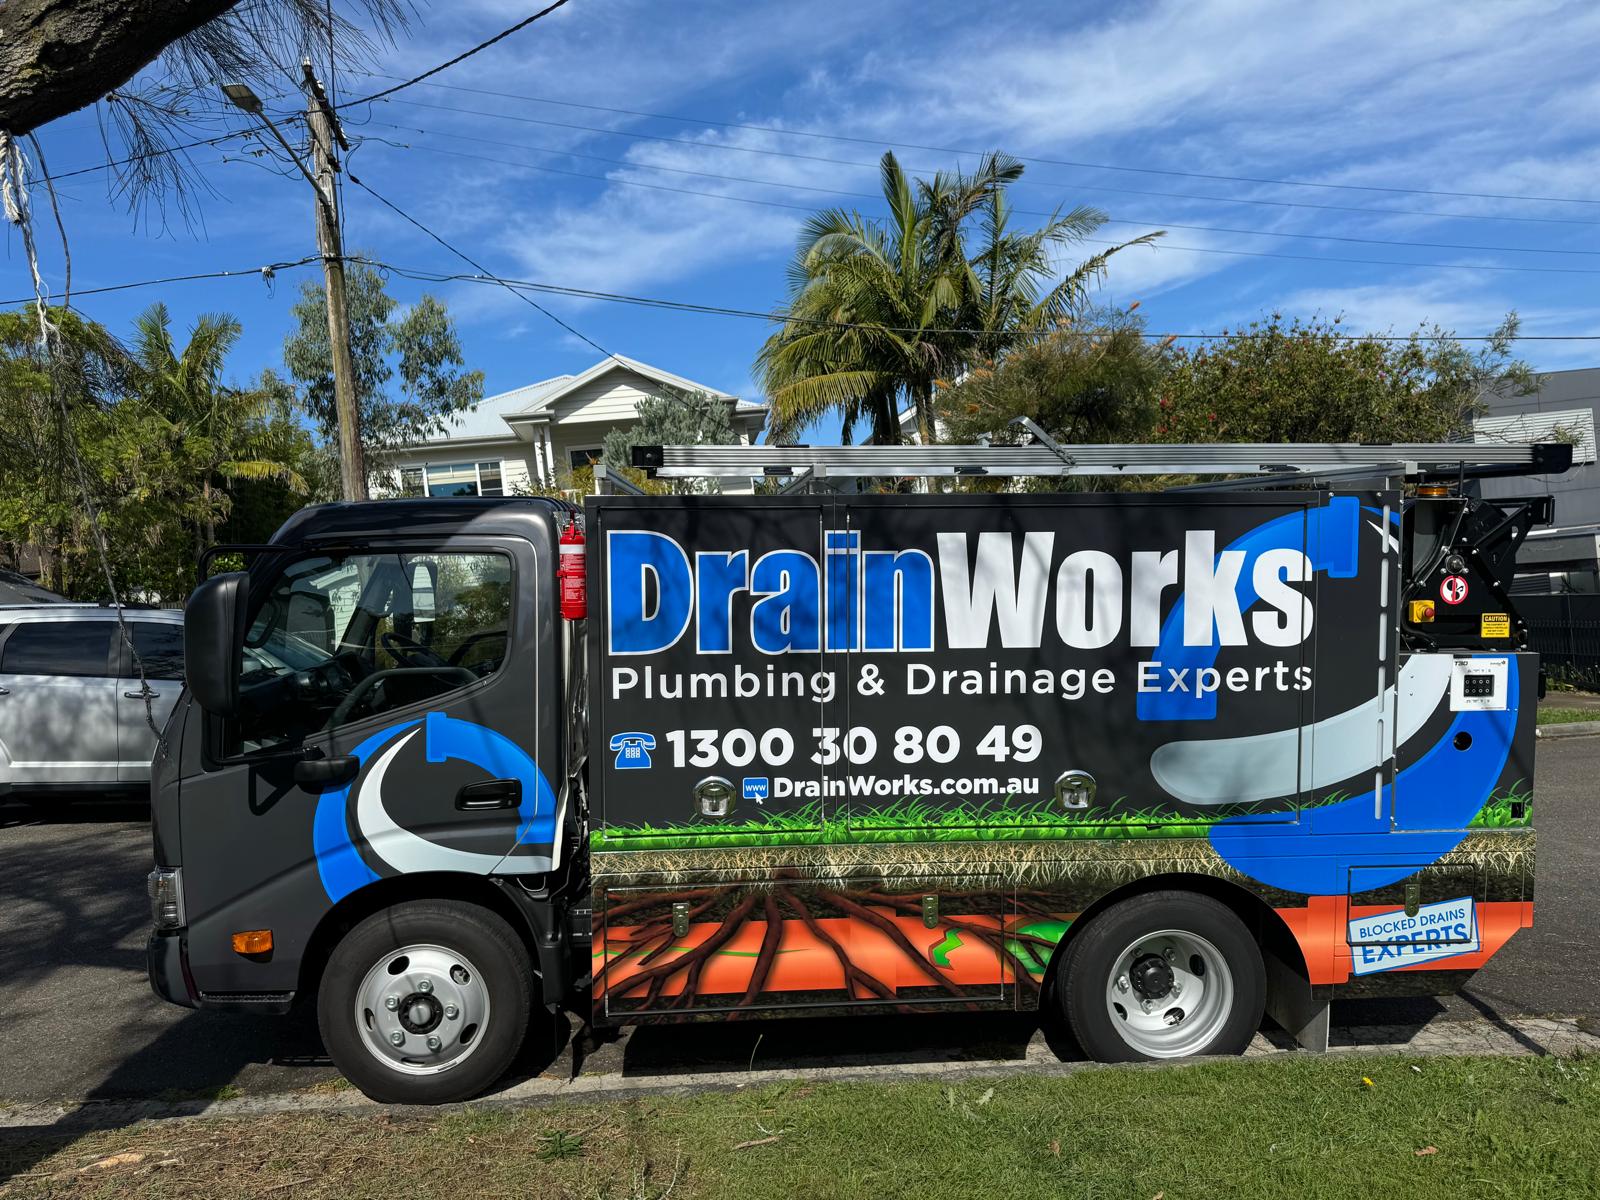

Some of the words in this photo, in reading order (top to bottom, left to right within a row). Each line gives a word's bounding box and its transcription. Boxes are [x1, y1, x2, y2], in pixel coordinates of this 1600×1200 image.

[612, 665, 836, 703] Plumbing
[857, 663, 885, 695] &
[907, 661, 1116, 700] Drainage
[1137, 660, 1313, 698] Experts
[665, 728, 795, 768] 1300
[810, 726, 878, 765] 30
[893, 725, 961, 764] 80
[976, 724, 1043, 763] 49
[773, 774, 1039, 798] DrainWorks.com.au
[1360, 918, 1416, 938] BLOCKED
[1420, 908, 1465, 926] DRAINS
[1363, 923, 1468, 964] EXPERTS
